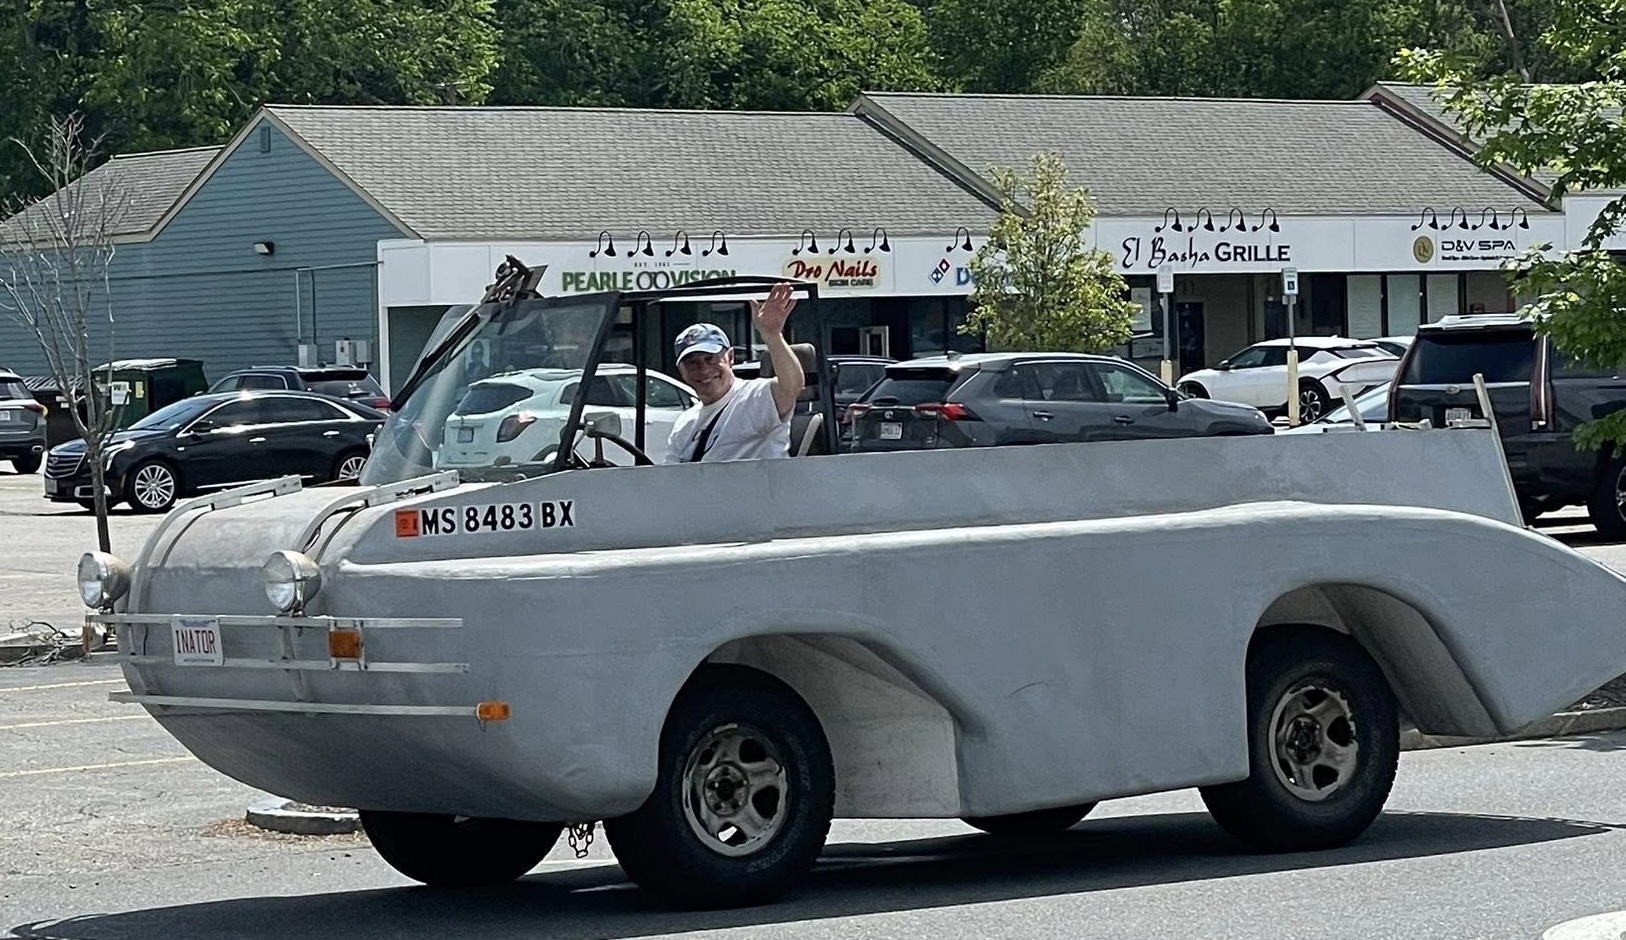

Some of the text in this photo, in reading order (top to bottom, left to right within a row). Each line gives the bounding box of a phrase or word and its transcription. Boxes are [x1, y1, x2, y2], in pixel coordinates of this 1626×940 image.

[1122, 236, 1291, 268] El Basha GRILLE
[1441, 240, 1475, 252] D&V
[1478, 240, 1515, 251] SPA
[562, 271, 634, 292] PEARLE
[787, 259, 878, 282] Pro Nails
[421, 508, 456, 535] MS
[464, 503, 533, 532] 8483
[542, 501, 574, 528] BX
[175, 629, 217, 654] INATOR
